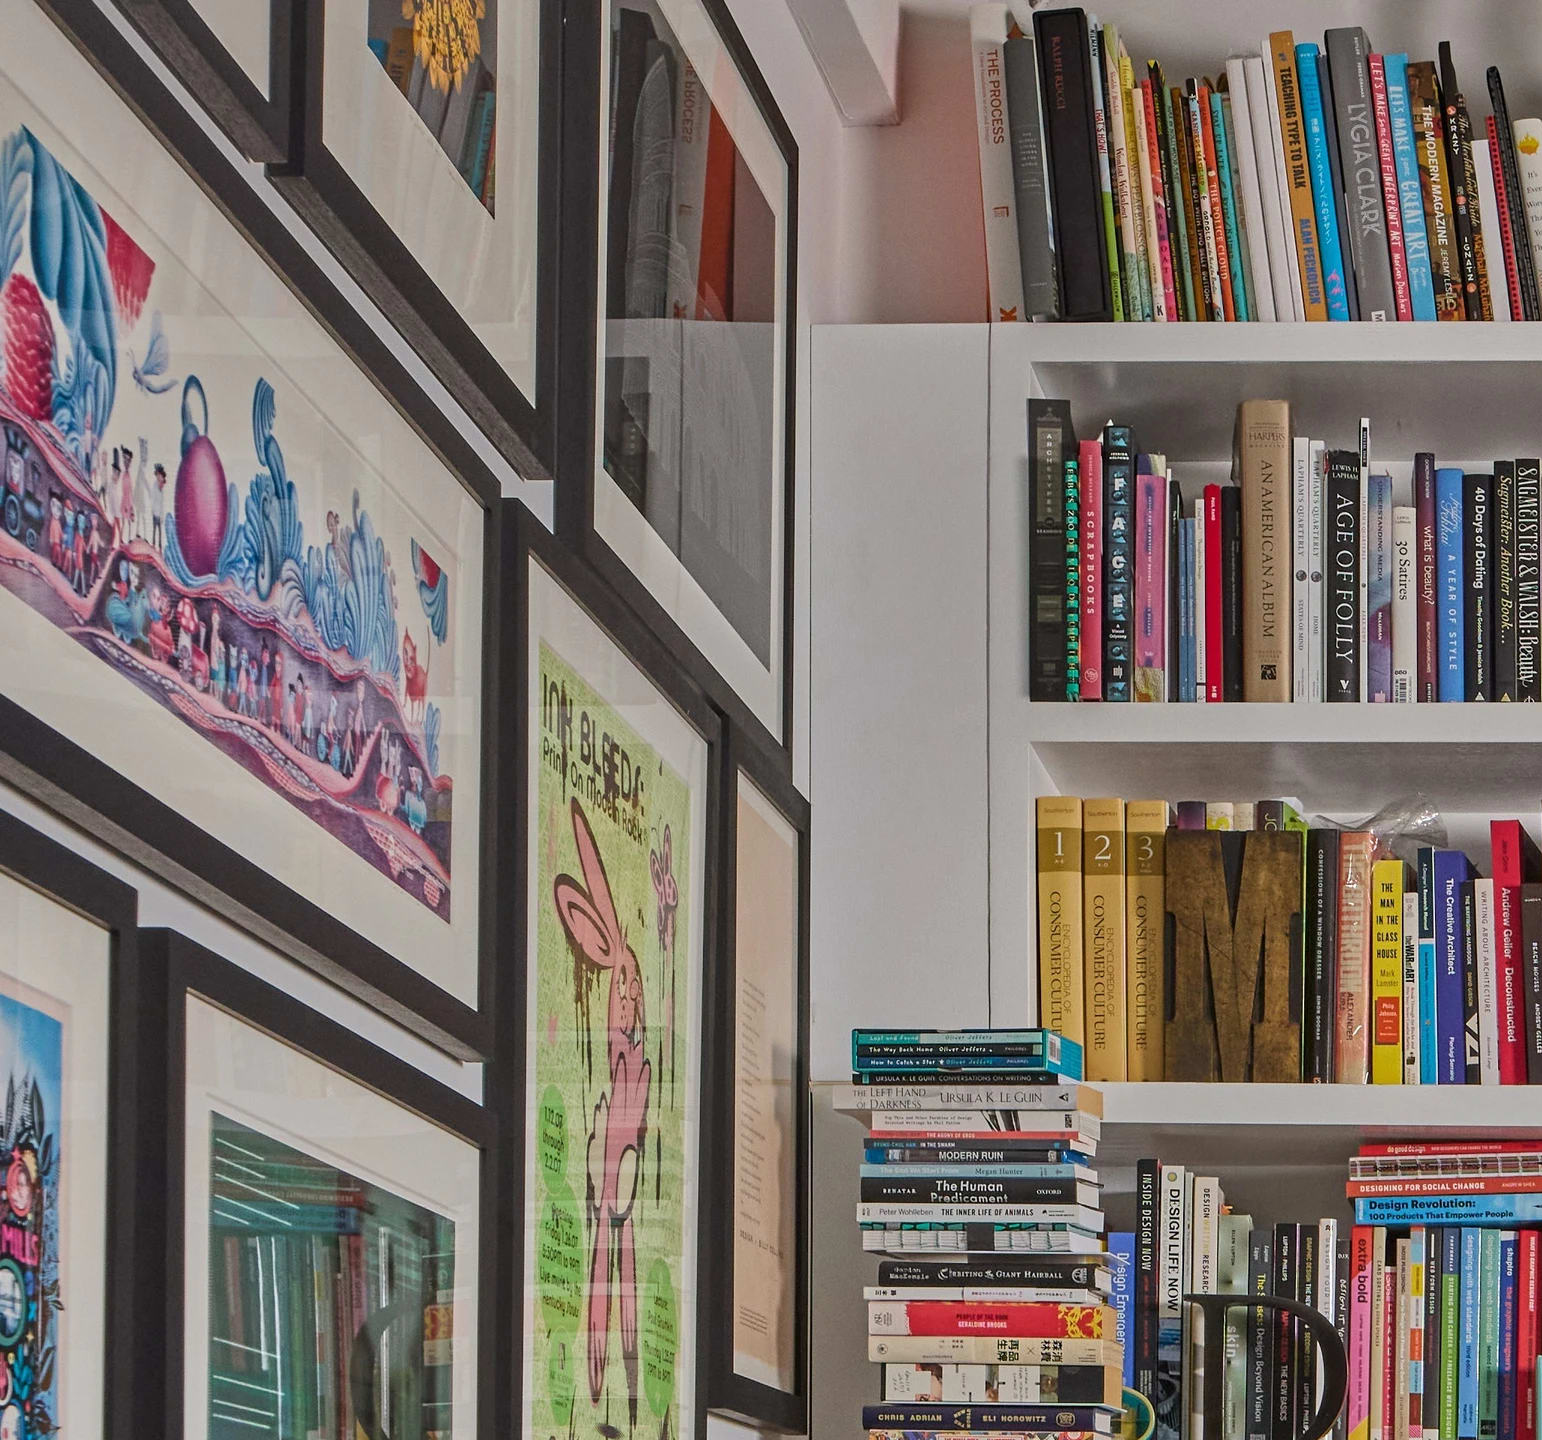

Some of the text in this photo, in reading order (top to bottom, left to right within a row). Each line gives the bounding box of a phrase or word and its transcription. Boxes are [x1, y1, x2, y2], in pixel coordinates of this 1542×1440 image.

[1346, 103, 1380, 238] LYGIA CLARK
[1335, 493, 1354, 664] AGE OF FOLLY
[936, 1180, 1003, 1191] The Human
[939, 1151, 1004, 1161] MODERN RUIN
[1369, 1199, 1476, 1212] Design Revolution:
[1167, 1189, 1180, 1311] DESIGN LIFE NOW
